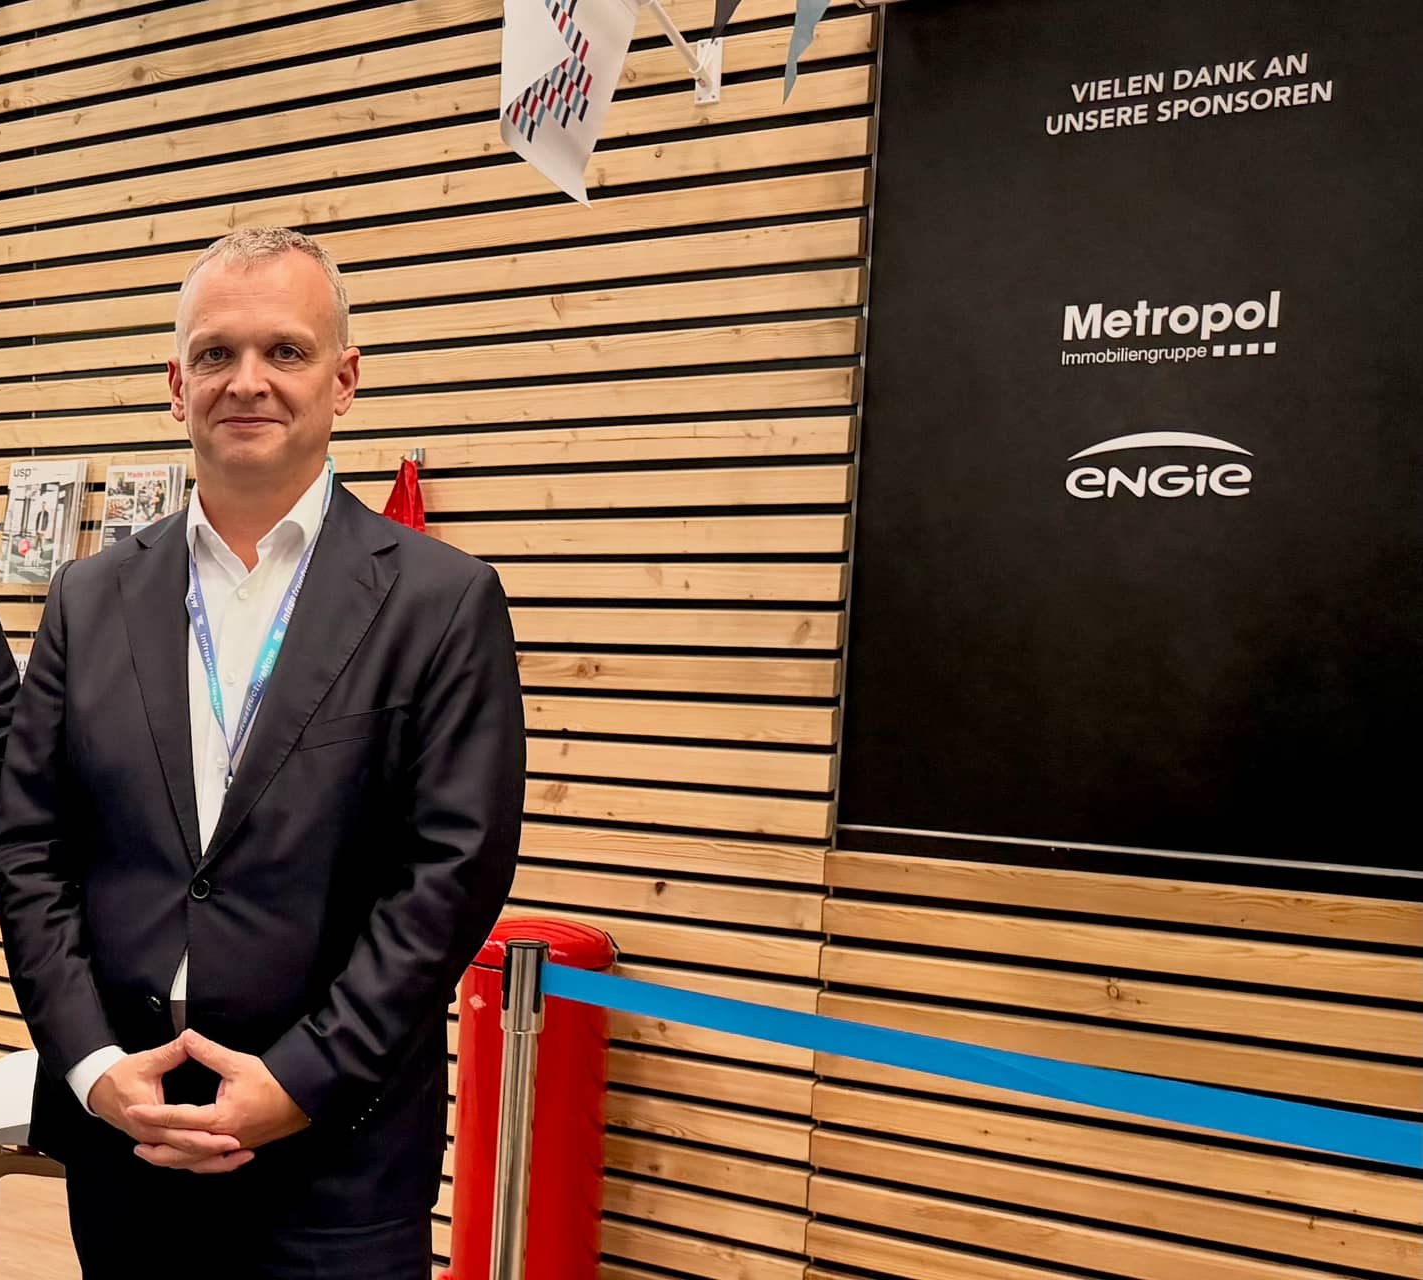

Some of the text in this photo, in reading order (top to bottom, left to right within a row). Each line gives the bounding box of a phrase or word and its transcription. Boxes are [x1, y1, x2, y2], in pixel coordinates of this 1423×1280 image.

[1071, 53, 1309, 103] VIELEN DANK AN
[1045, 81, 1334, 135] UNSERE SPONSOREN
[1063, 290, 1281, 341] Metropol
[1061, 345, 1207, 366] Immobiliengruppe
[13, 467, 32, 480] usp
